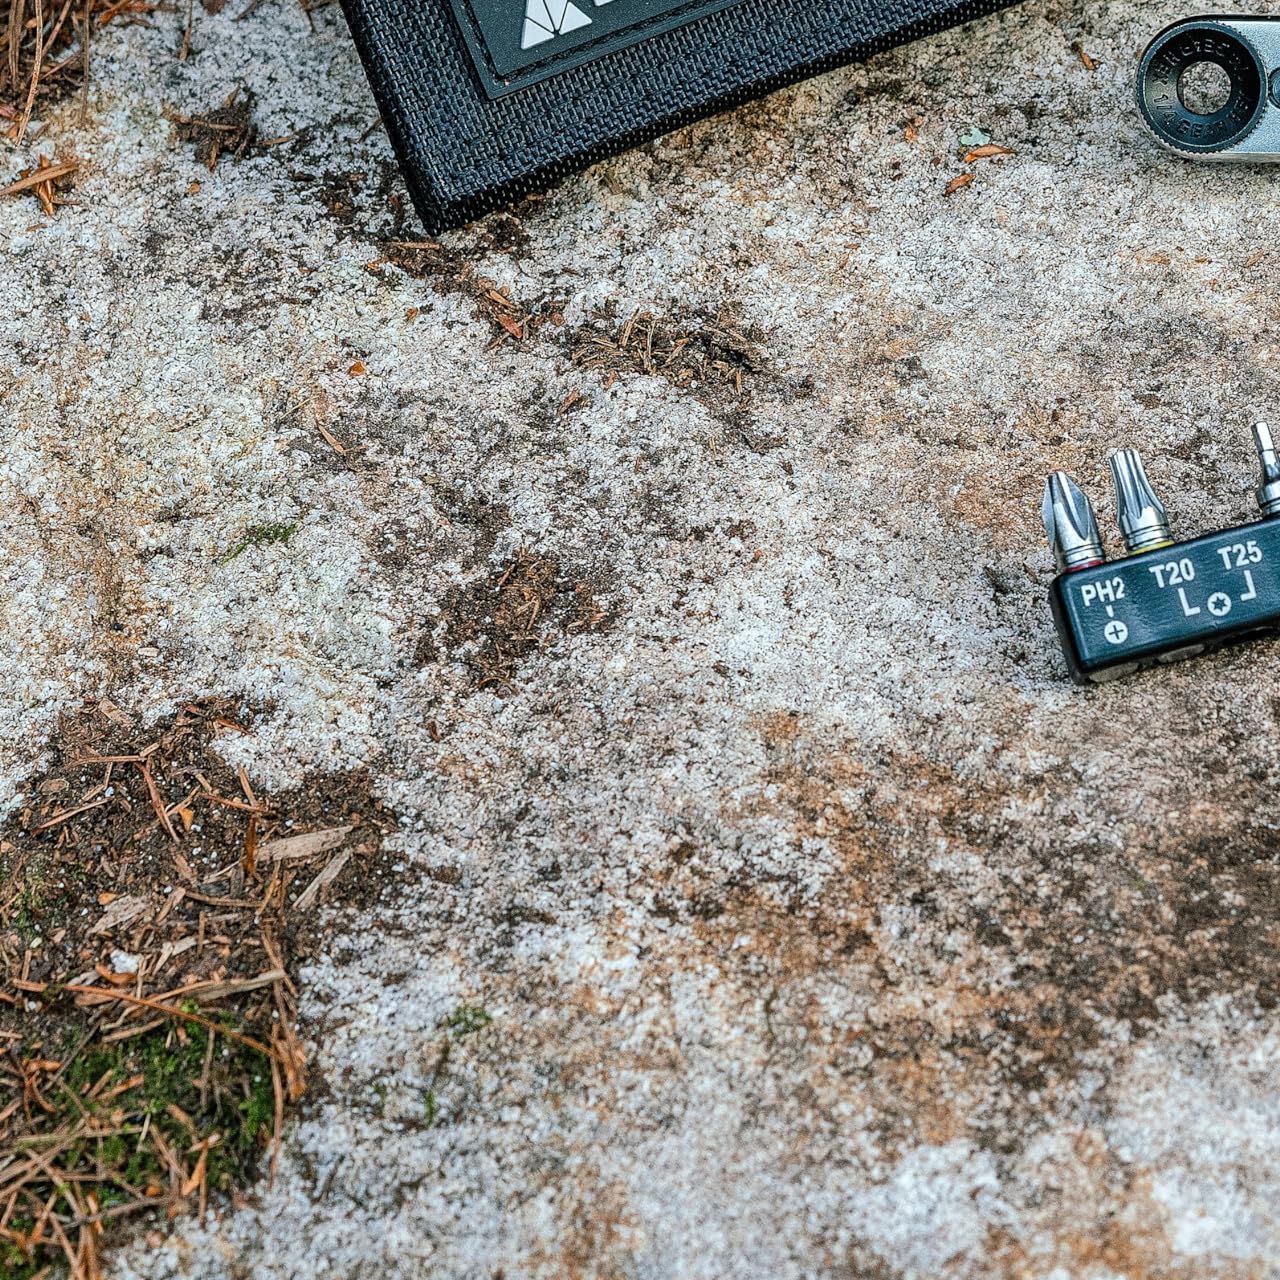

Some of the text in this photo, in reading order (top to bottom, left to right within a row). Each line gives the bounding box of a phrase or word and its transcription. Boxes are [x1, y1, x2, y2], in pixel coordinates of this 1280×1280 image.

[1081, 541, 1262, 607] PH2 T20 T25
